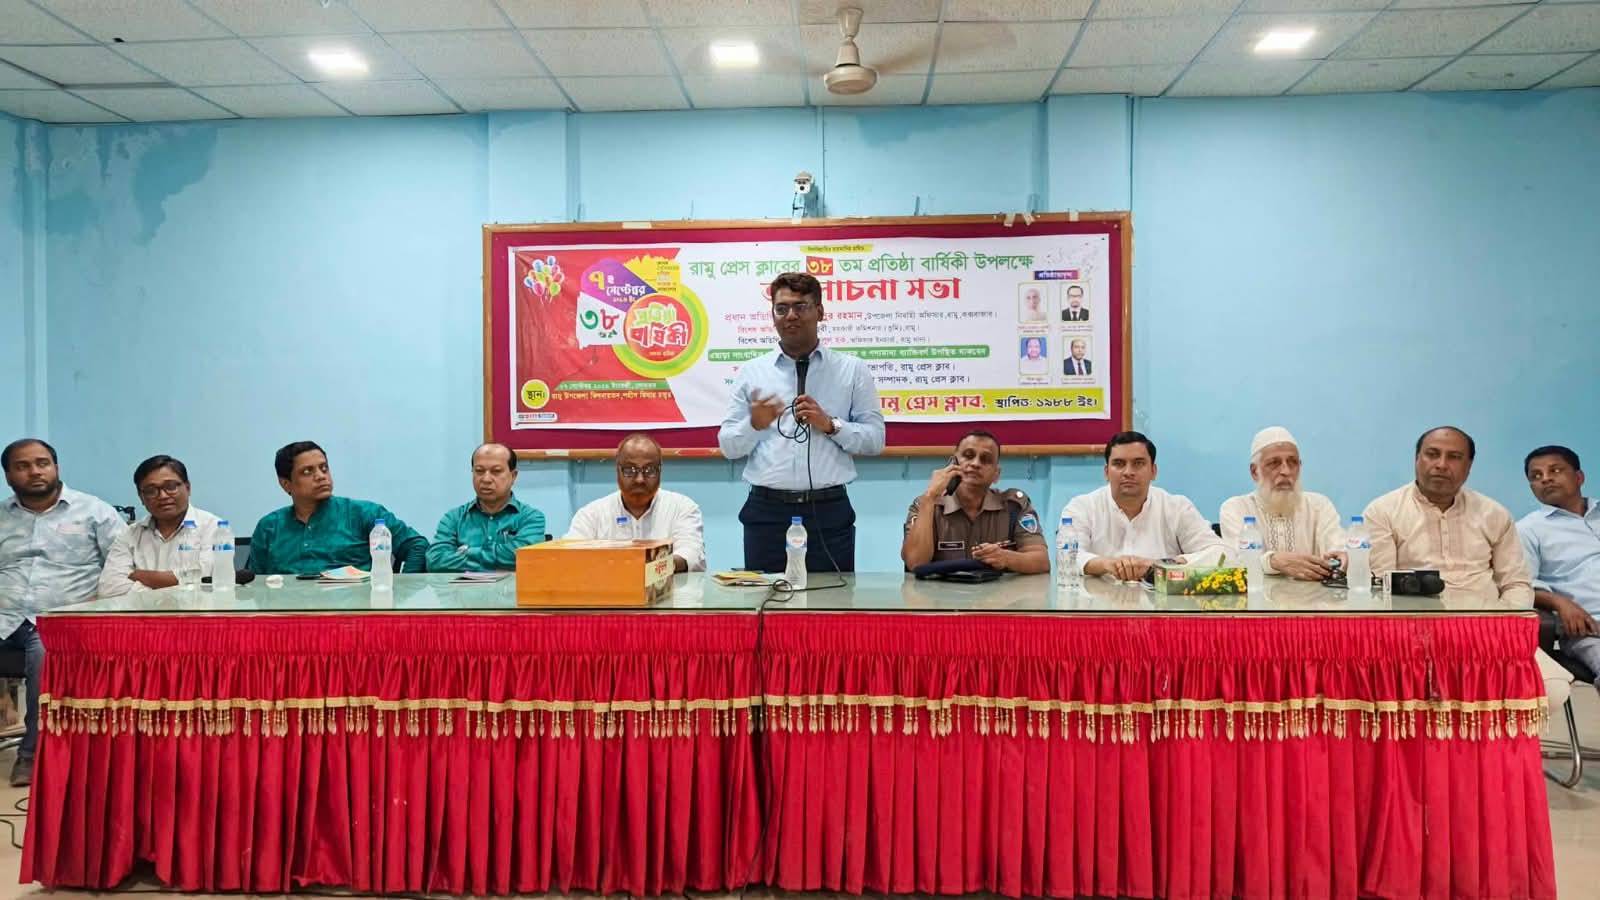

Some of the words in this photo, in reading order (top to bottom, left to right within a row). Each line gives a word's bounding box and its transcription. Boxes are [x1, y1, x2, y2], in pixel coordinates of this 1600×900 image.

[688, 261, 716, 279] রামু
[720, 260, 751, 276] প্রেস
[755, 259, 801, 277] ক্লাবের
[807, 260, 833, 273] ৩৮
[839, 258, 864, 273] তম
[868, 251, 916, 273] প্রতিষ্ঠা
[920, 250, 969, 272] বার্ষিকী
[973, 251, 1035, 272] উপলক্ষে
[904, 276, 963, 300] সভা
[580, 308, 620, 330] ৩৮
[629, 320, 689, 348] বার্ষিকী
[900, 363, 914, 373] রামু
[916, 363, 932, 371] প্রেস
[915, 375, 928, 385] রামু
[931, 375, 947, 384] প্রেস
[880, 396, 900, 413] ামু
[906, 395, 939, 411] প্রেস
[1036, 397, 1074, 408] ১৯৮৮
